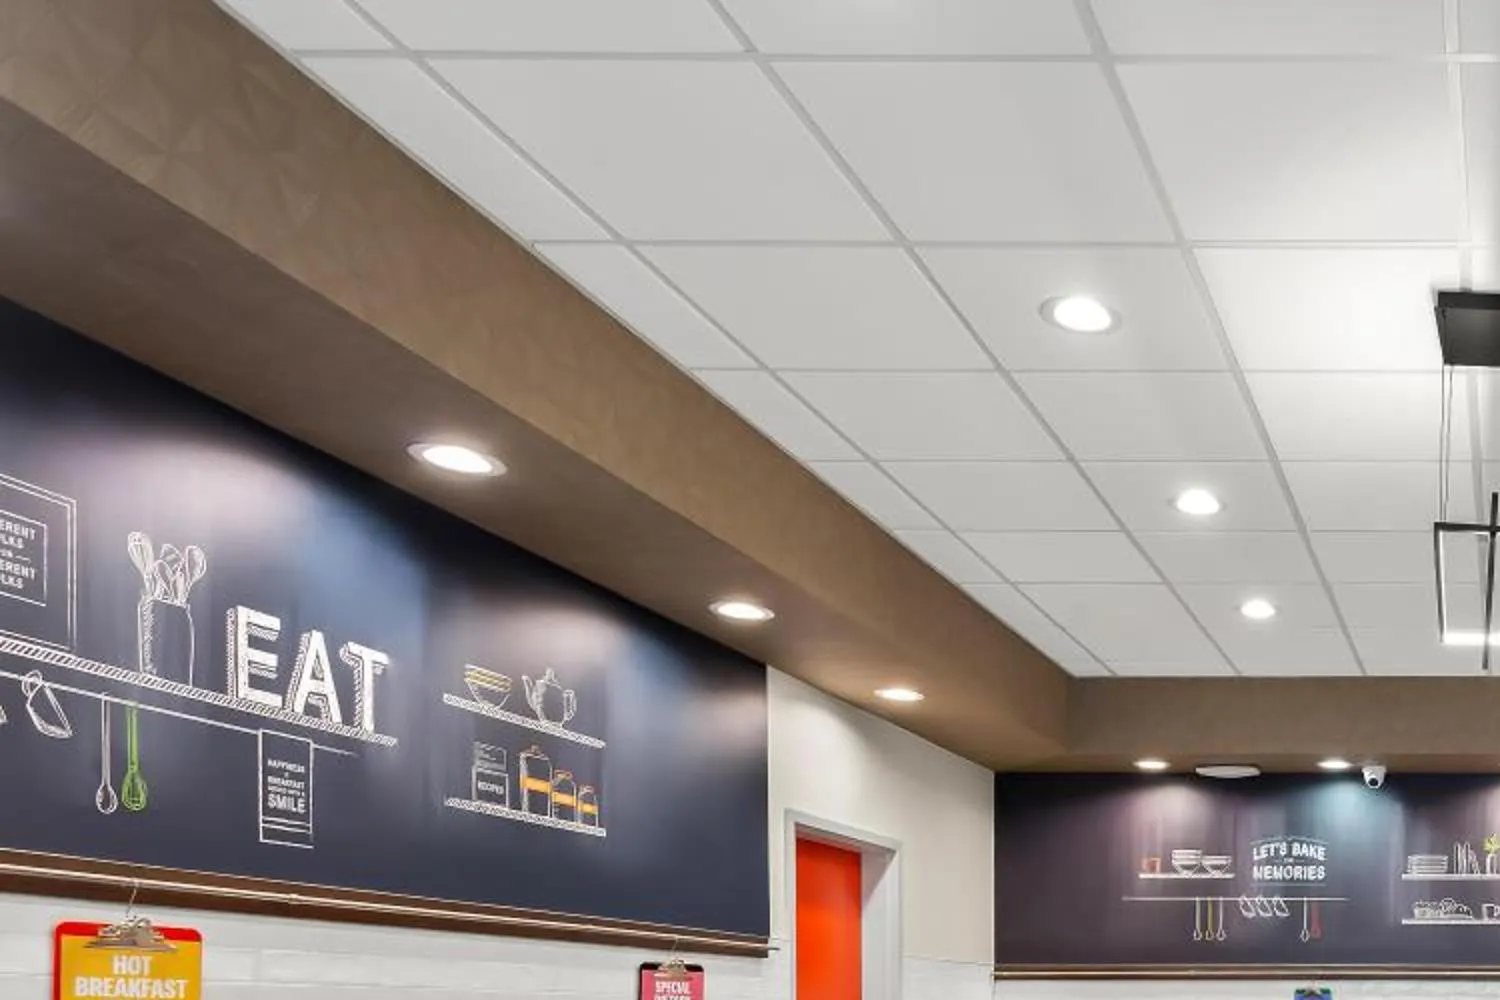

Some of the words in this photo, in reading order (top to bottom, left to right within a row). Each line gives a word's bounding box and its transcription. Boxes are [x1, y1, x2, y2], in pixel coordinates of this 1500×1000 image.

[226, 604, 391, 733] EAT
[267, 793, 306, 814] SMILE
[1253, 841, 1287, 860] LET'S
[1292, 841, 1328, 860] BAKE
[1252, 864, 1326, 881] MEMORIES
[112, 954, 153, 975] HOT
[75, 976, 189, 999] BREAKFAST
